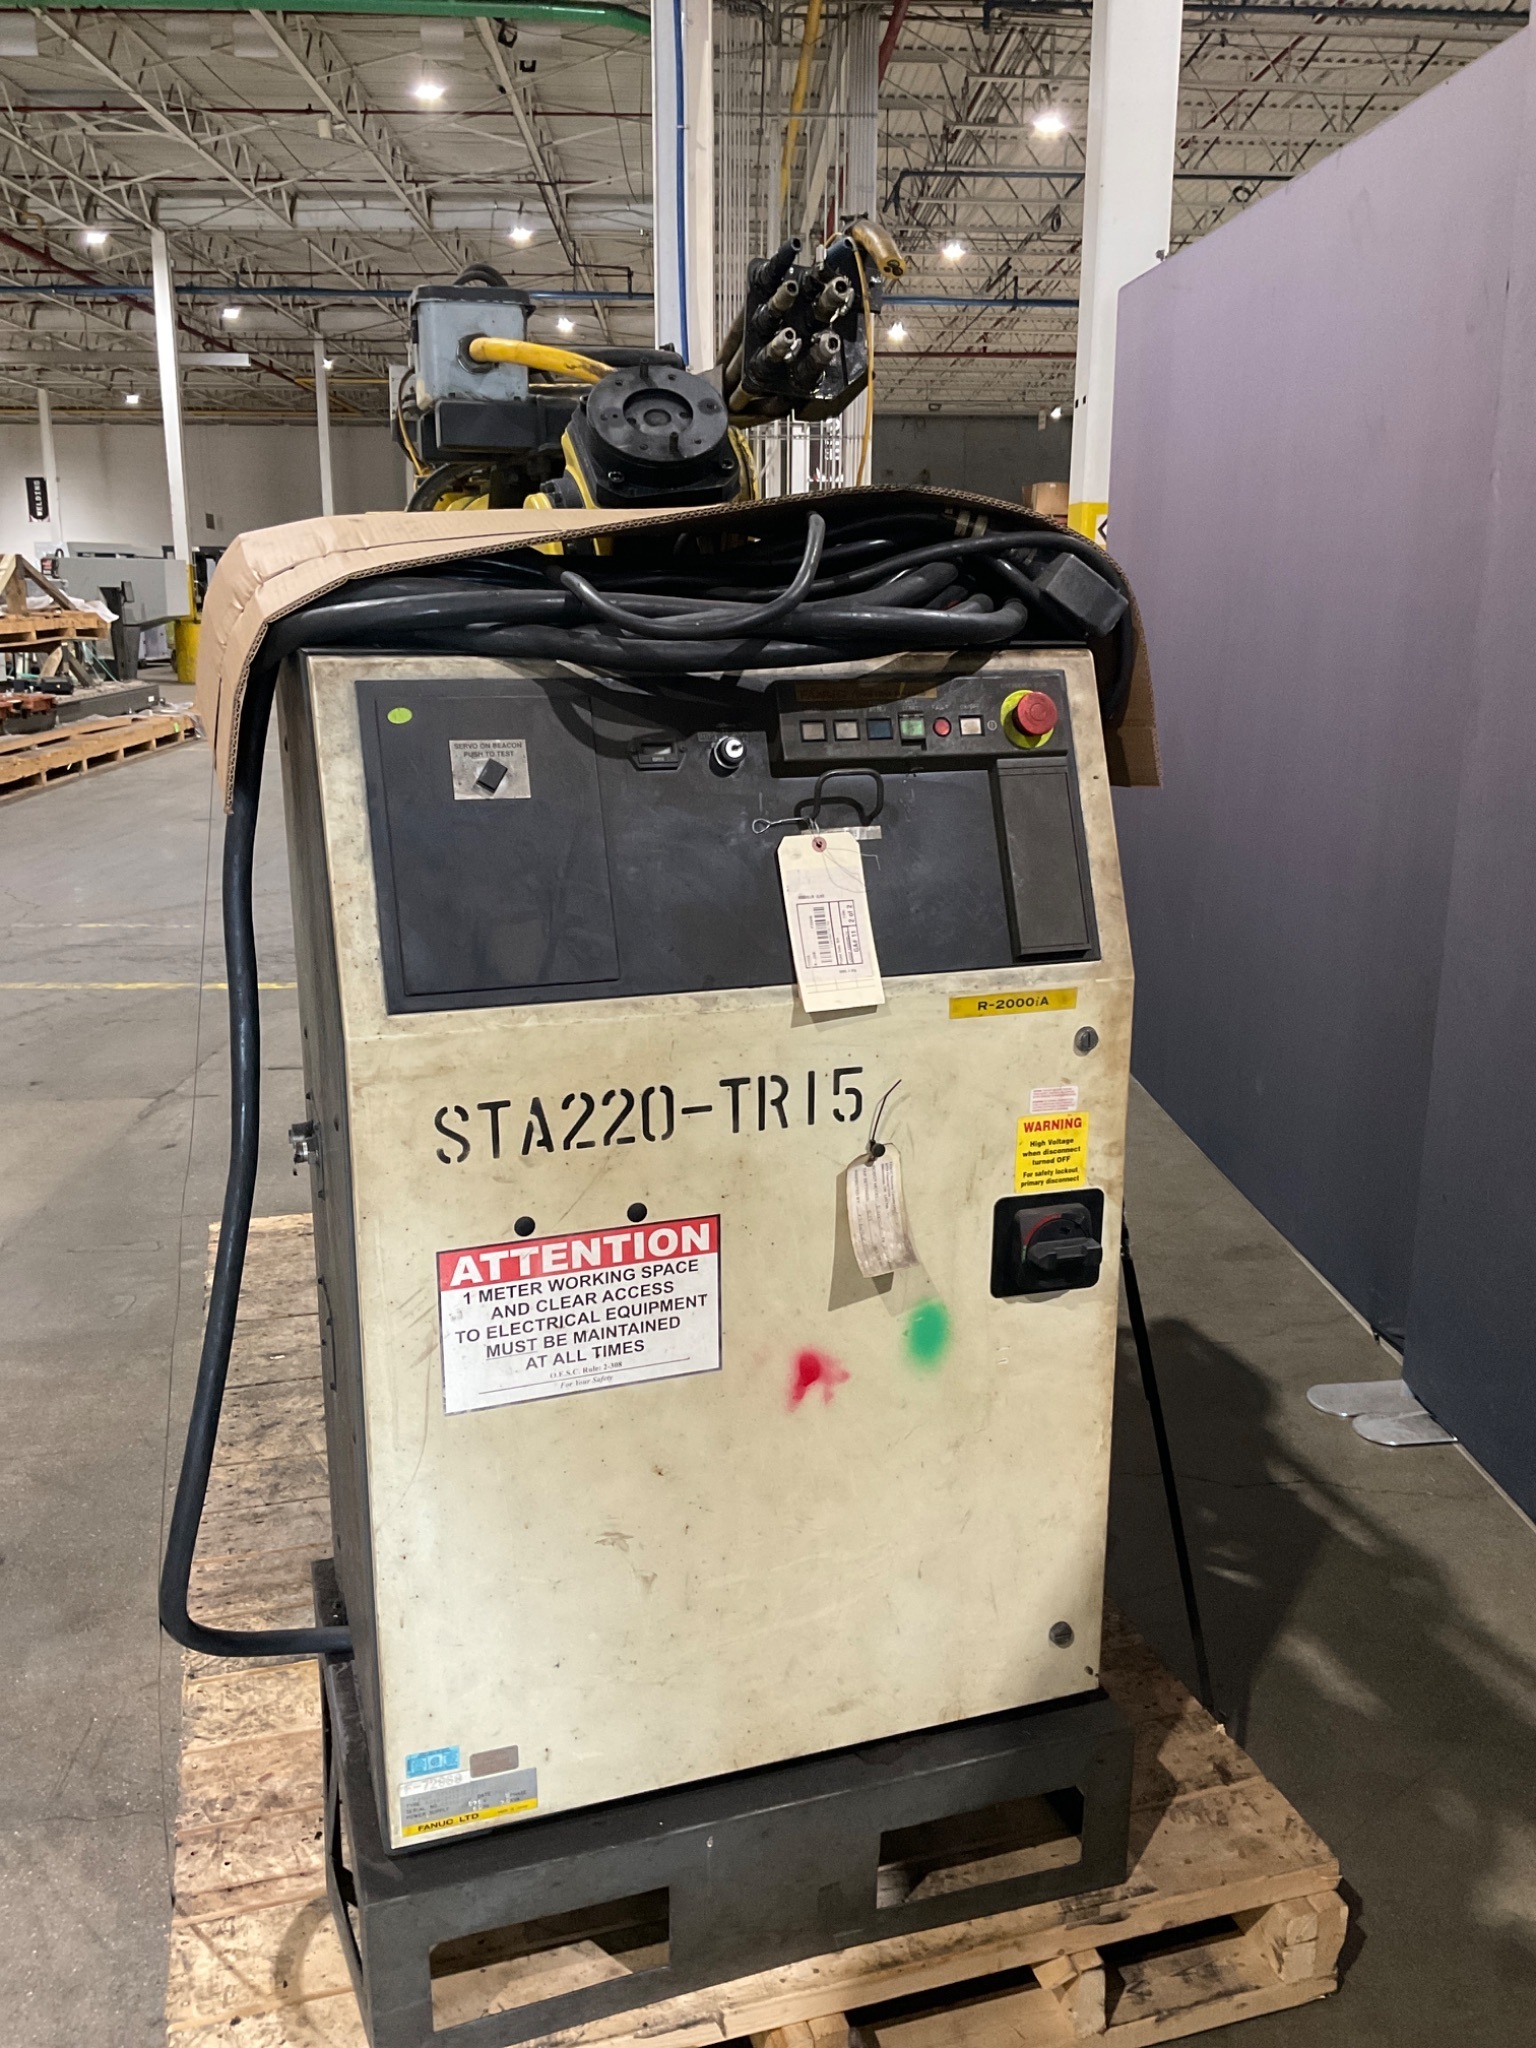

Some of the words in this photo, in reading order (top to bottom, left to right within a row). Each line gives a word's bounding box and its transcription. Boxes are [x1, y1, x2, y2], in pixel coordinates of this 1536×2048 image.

[34, 480, 44, 516] WELDING
[978, 996, 1050, 1011] R-2000iA
[1024, 1117, 1082, 1133] WARNING
[1043, 1146, 1080, 1155] disconnect
[1055, 1167, 1078, 1175] lockout
[1021, 1180, 1044, 1188] primary
[1046, 1176, 1079, 1184] disconnect
[450, 1223, 710, 1287] ATTENTION
[463, 1292, 471, 1305] 1
[478, 1282, 543, 1303] METER
[548, 1268, 636, 1292] WORKING
[641, 1259, 699, 1279] SPACE
[491, 1302, 530, 1320] AND
[536, 1292, 598, 1313] CLEAR
[602, 1281, 675, 1304] ACCESS
[455, 1328, 480, 1344] TO
[486, 1311, 601, 1340] ELECTRICAL
[606, 1293, 709, 1321] EQUIPMENT
[486, 1338, 538, 1358] MUST
[544, 1332, 568, 1350] BE
[573, 1316, 681, 1345] MAINTAINED
[526, 1355, 549, 1371] AT
[552, 1348, 588, 1367] ALL
[592, 1339, 646, 1360] TIMES
[582, 1363, 602, 1374] Rule:
[603, 1360, 624, 1371] 2-308
[560, 1380, 574, 1390] For
[575, 1376, 591, 1387] Your
[592, 1374, 614, 1386] Safety
[418, 1818, 454, 1832] FANUC
[459, 1812, 480, 1823] LTD
